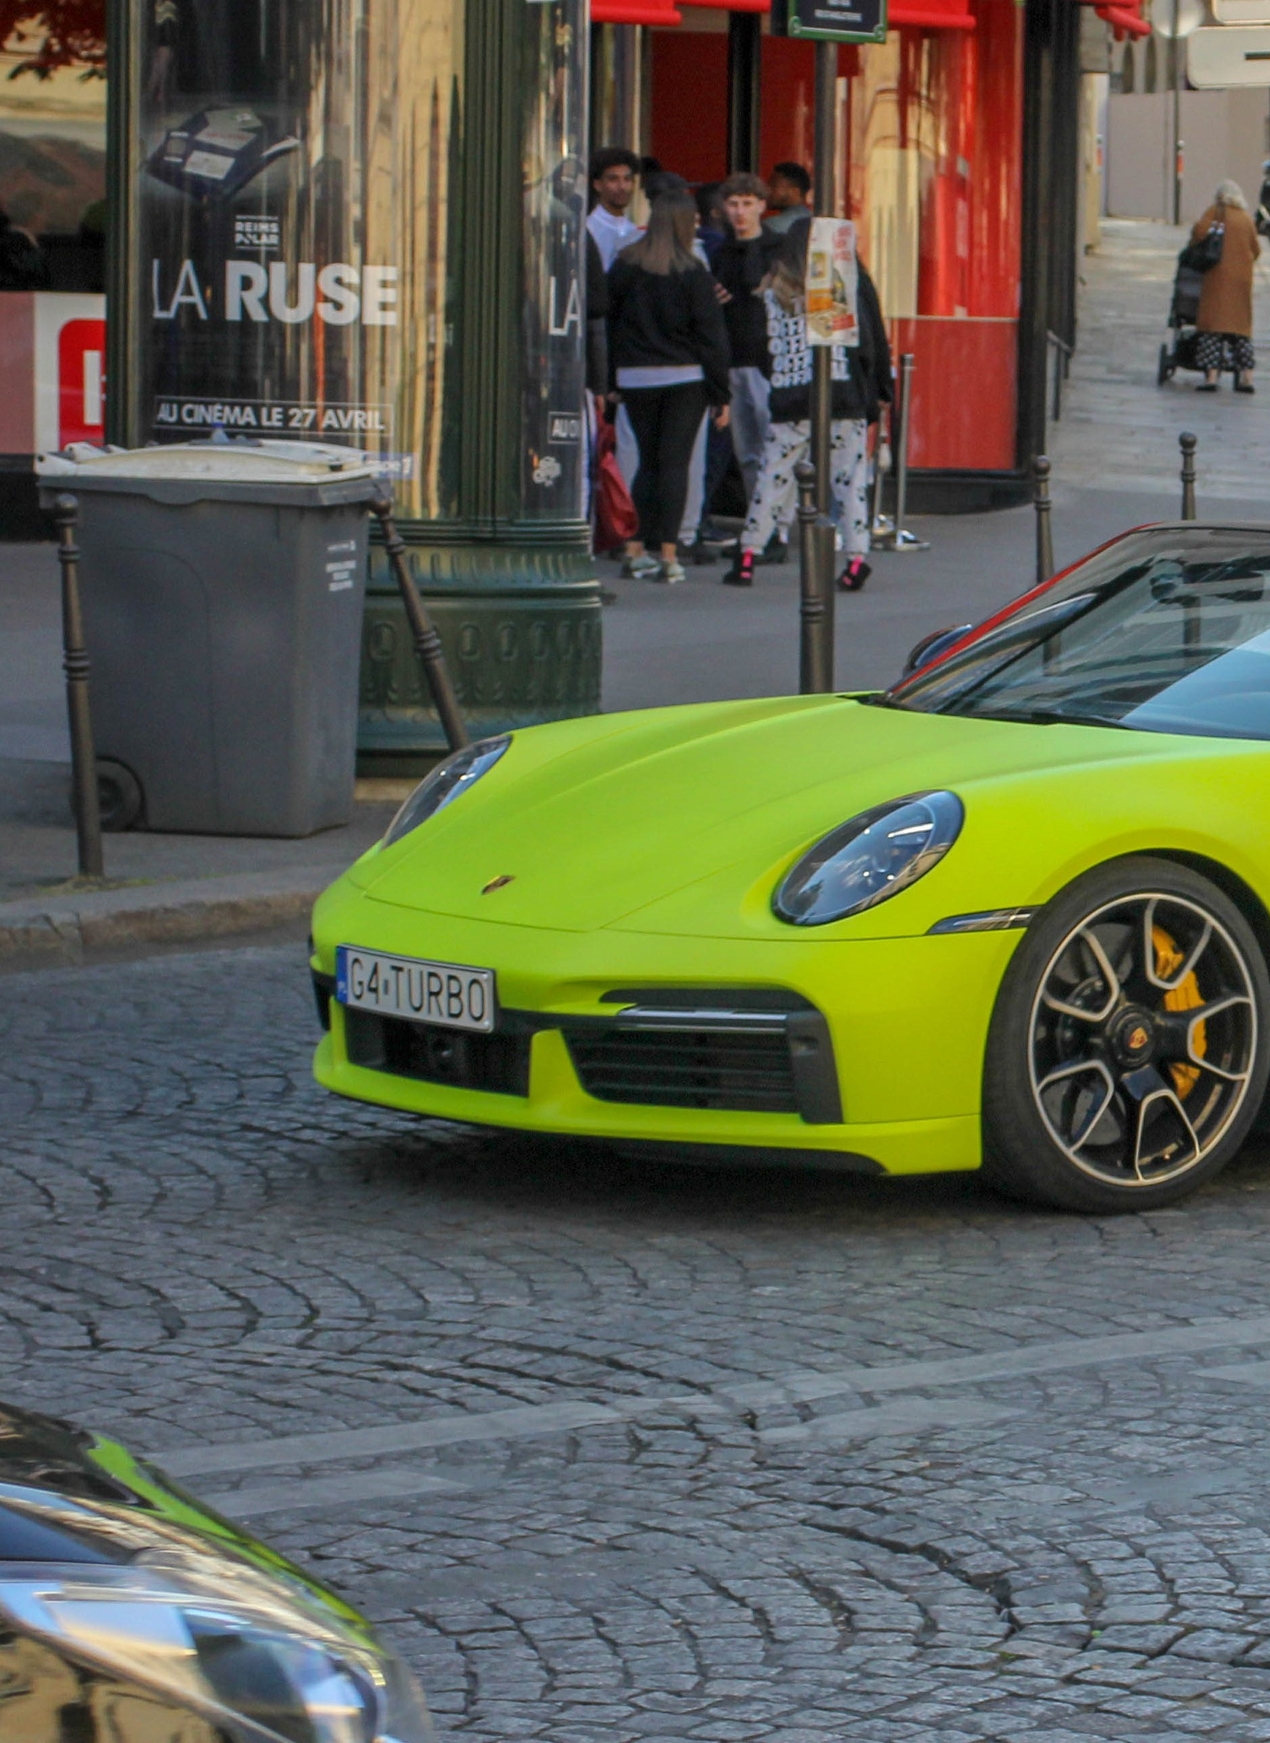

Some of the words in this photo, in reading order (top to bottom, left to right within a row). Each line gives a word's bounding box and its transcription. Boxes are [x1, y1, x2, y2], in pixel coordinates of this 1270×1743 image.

[235, 222, 279, 232] REIMS
[152, 258, 208, 321] LA
[225, 260, 397, 326] RUSE
[549, 276, 582, 337] LA
[157, 403, 177, 423] AU
[181, 402, 257, 426] CINÉMA
[261, 408, 284, 427] LE
[288, 408, 317, 429] 27
[322, 409, 385, 430] AVRIL
